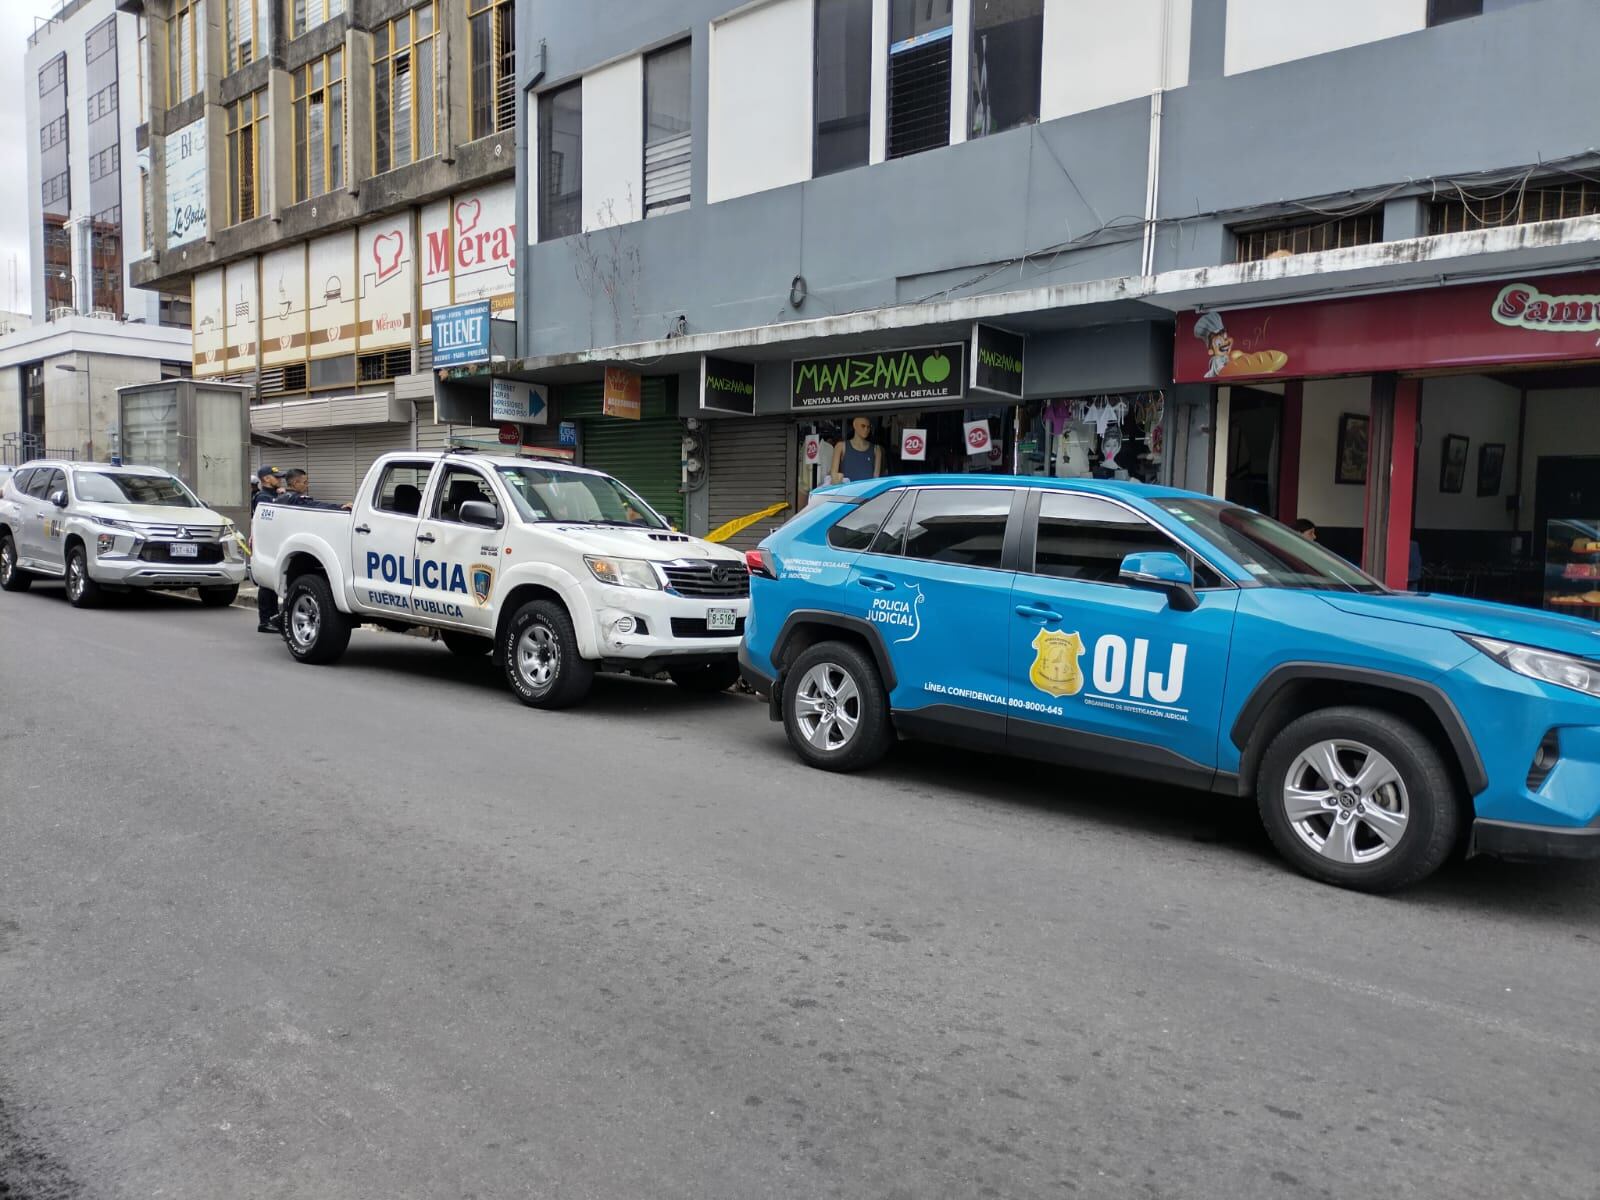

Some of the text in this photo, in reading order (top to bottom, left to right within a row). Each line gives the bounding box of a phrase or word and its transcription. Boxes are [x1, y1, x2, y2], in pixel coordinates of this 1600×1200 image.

[376, 319, 402, 331] Merayo
[437, 315, 483, 348] TELENET
[796, 351, 922, 394] MANZANA
[978, 347, 1015, 373] MANZANA
[706, 375, 746, 395] MANZANA
[844, 394, 861, 402] POR
[862, 393, 890, 401] MAYOR
[898, 390, 909, 398] AL
[911, 388, 948, 397] DETALLE
[261, 508, 275, 517] 2041
[366, 551, 468, 594] POLICIA
[368, 590, 464, 618] FUERZA PUBLICA
[872, 598, 910, 613] POLICIA
[865, 610, 915, 627] JUDICIAL
[1093, 634, 1188, 703] OIJ
[947, 686, 1007, 706] CONFIDENCIAL
[1008, 697, 1064, 716] 800-8000-645
[1084, 698, 1115, 710] ORGANISMO
[1123, 705, 1164, 718] INVESTIGACIÓN
[1164, 712, 1189, 722] JUDICIAL
